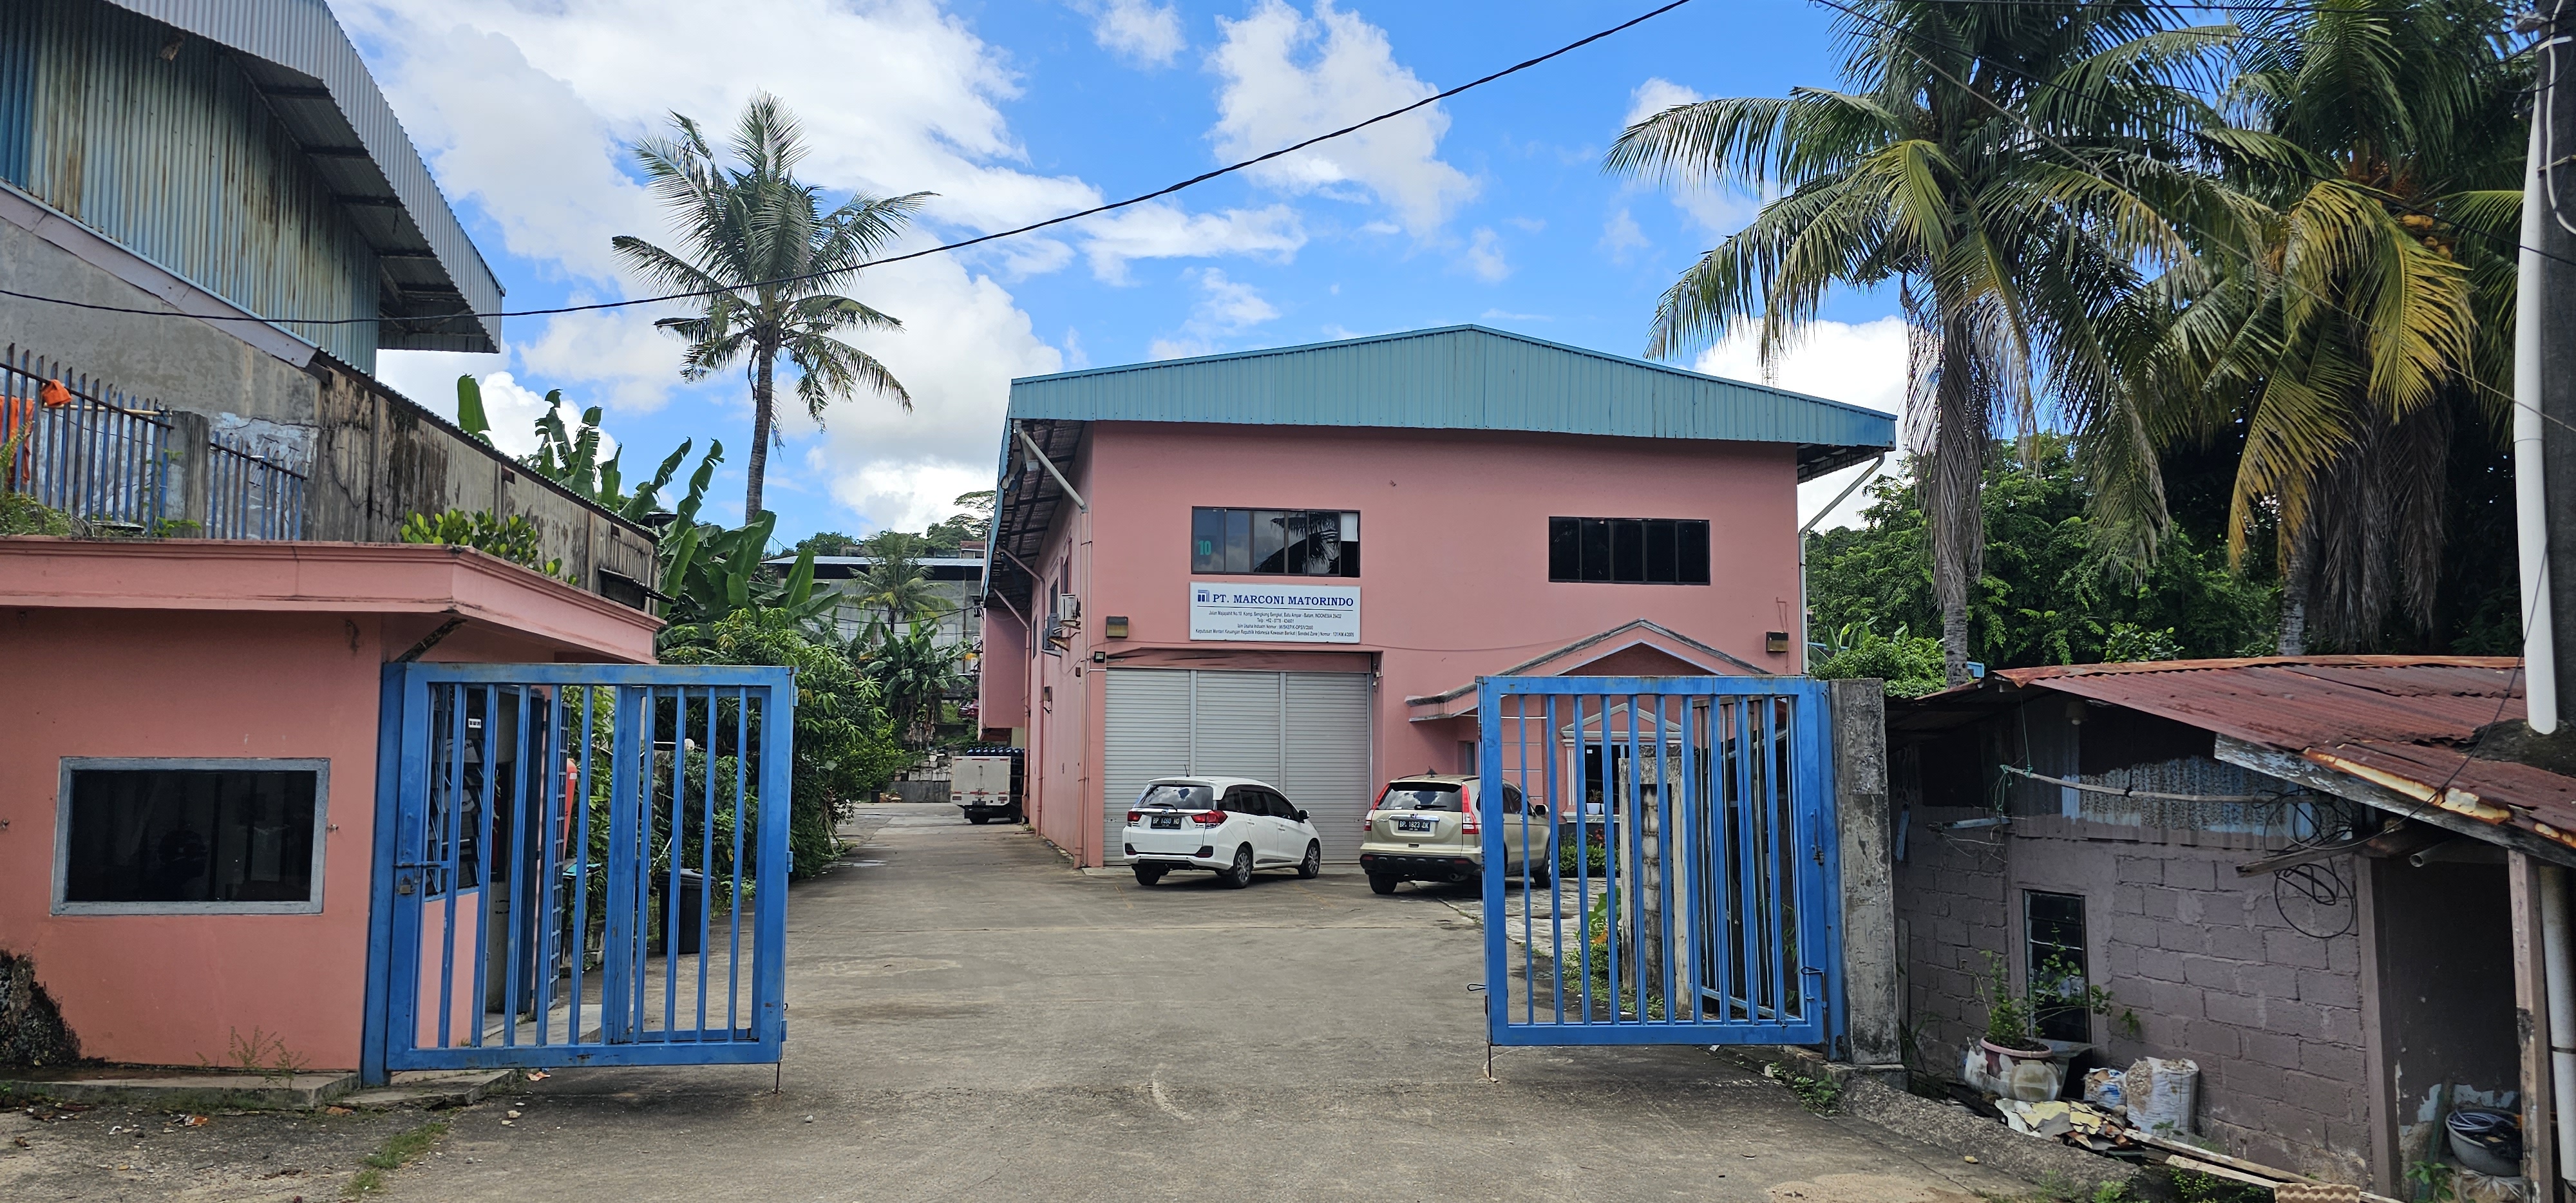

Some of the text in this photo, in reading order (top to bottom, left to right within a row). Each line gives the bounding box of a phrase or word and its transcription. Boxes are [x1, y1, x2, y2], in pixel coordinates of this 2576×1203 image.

[1198, 540, 1211, 555] 10
[1213, 594, 1354, 606] PT. MARCONI MATORINDO
